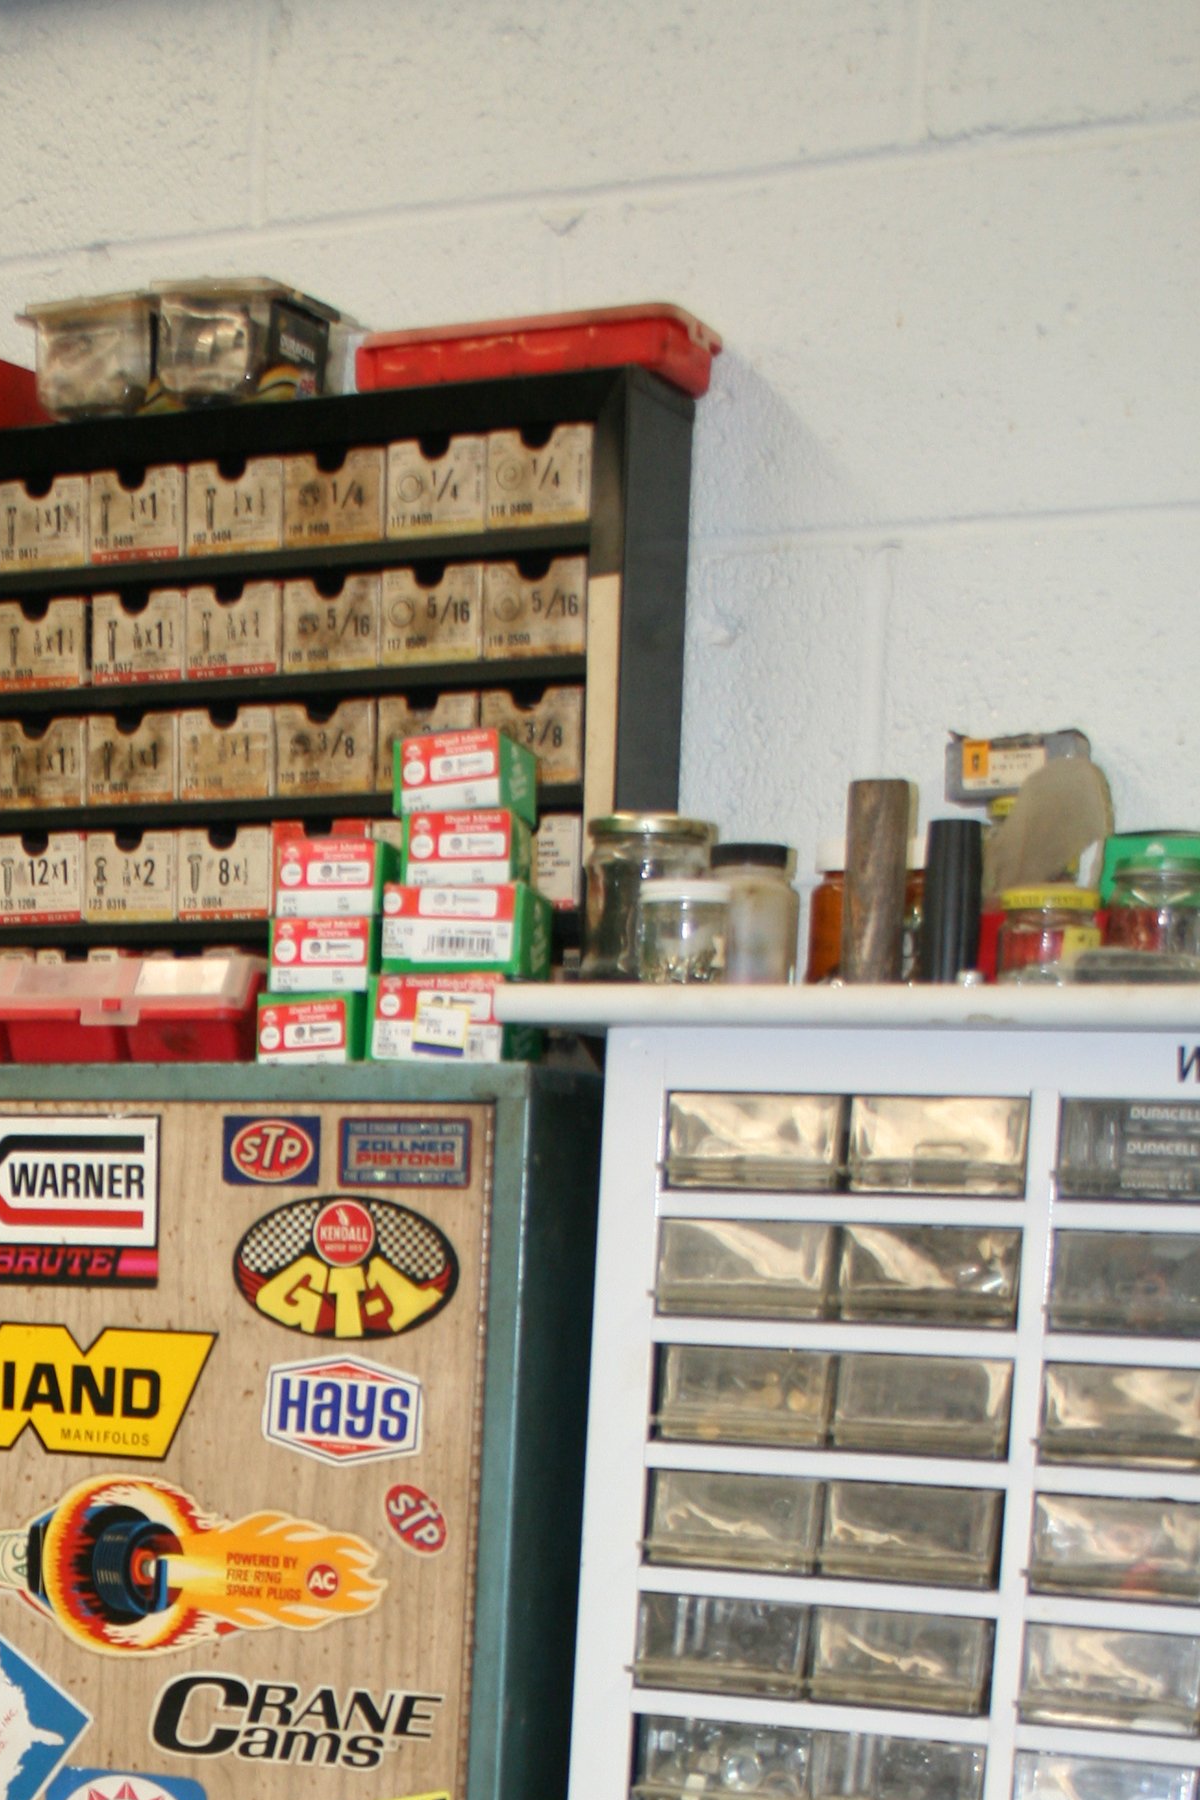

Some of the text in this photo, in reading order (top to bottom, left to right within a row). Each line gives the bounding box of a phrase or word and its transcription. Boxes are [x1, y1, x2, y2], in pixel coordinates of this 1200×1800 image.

[426, 597, 470, 625] 5/16
[240, 1127, 302, 1169] STP
[358, 1140, 455, 1152] ZOLLNER
[1126, 1141, 1199, 1156] DURACELL
[356, 1153, 455, 1167] PISTONS
[9, 1163, 145, 1199] WARNER
[319, 1225, 368, 1243] KENDALL
[278, 1378, 410, 1442] Hays
[60, 1428, 150, 1446] MANIFOLDS
[390, 1491, 442, 1549] STP
[226, 1552, 298, 1569] POWERED BY
[308, 1570, 337, 1589] AC
[225, 1583, 302, 1601] SPARK PLUGS
